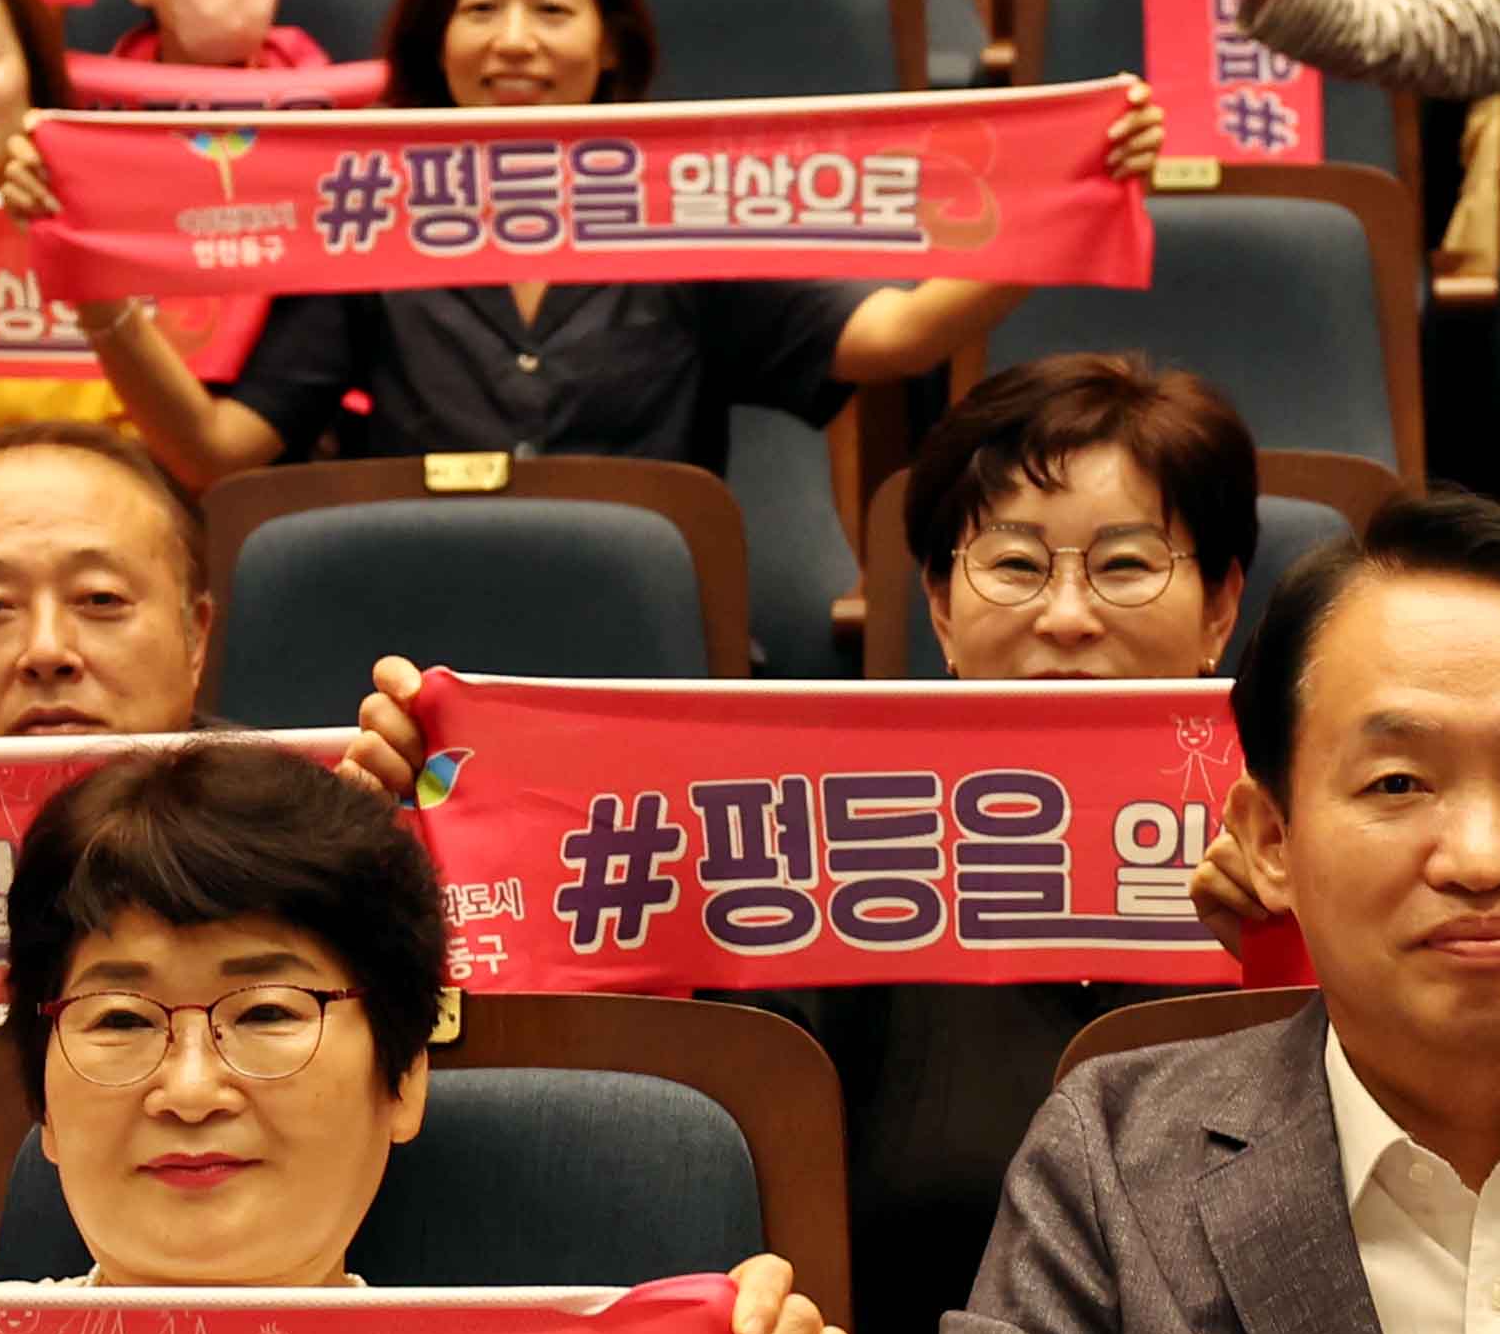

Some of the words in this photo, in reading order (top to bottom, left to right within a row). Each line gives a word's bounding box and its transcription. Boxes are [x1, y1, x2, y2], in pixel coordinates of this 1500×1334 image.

[316, 138, 643, 255] #평등을
[669, 151, 920, 229] 일상으로
[556, 769, 1073, 955] #평등을
